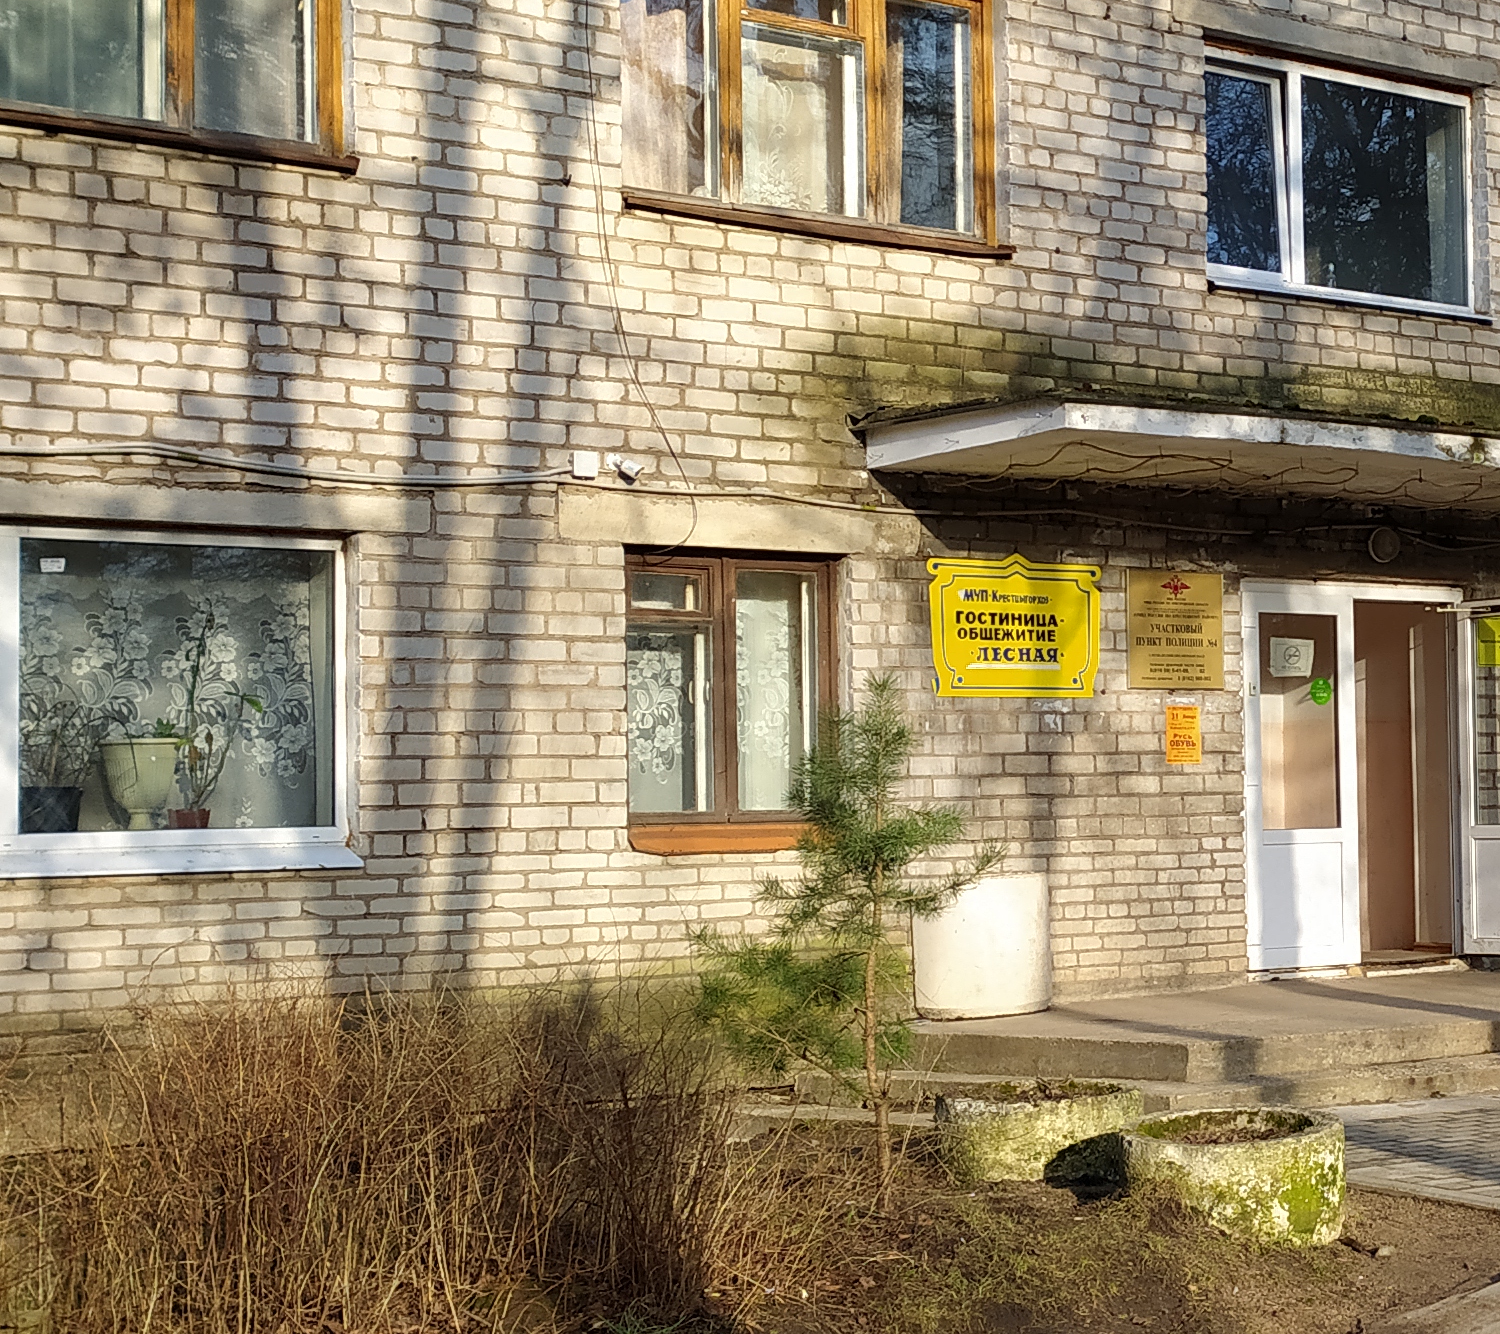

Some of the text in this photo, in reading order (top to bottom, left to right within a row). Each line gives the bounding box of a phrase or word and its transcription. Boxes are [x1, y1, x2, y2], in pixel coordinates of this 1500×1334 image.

[957, 627, 1056, 643] ОБЩЕЖИТИЕ
[1150, 622, 1203, 635] УЧАСТКОВЫЙ
[1135, 636, 1162, 647] ПУНКТ
[1165, 637, 1204, 648] ПОЛИЦИИ
[976, 647, 1059, 664] ЛЕСНАЯ
[1169, 740, 1197, 748] ОБУВЬ
